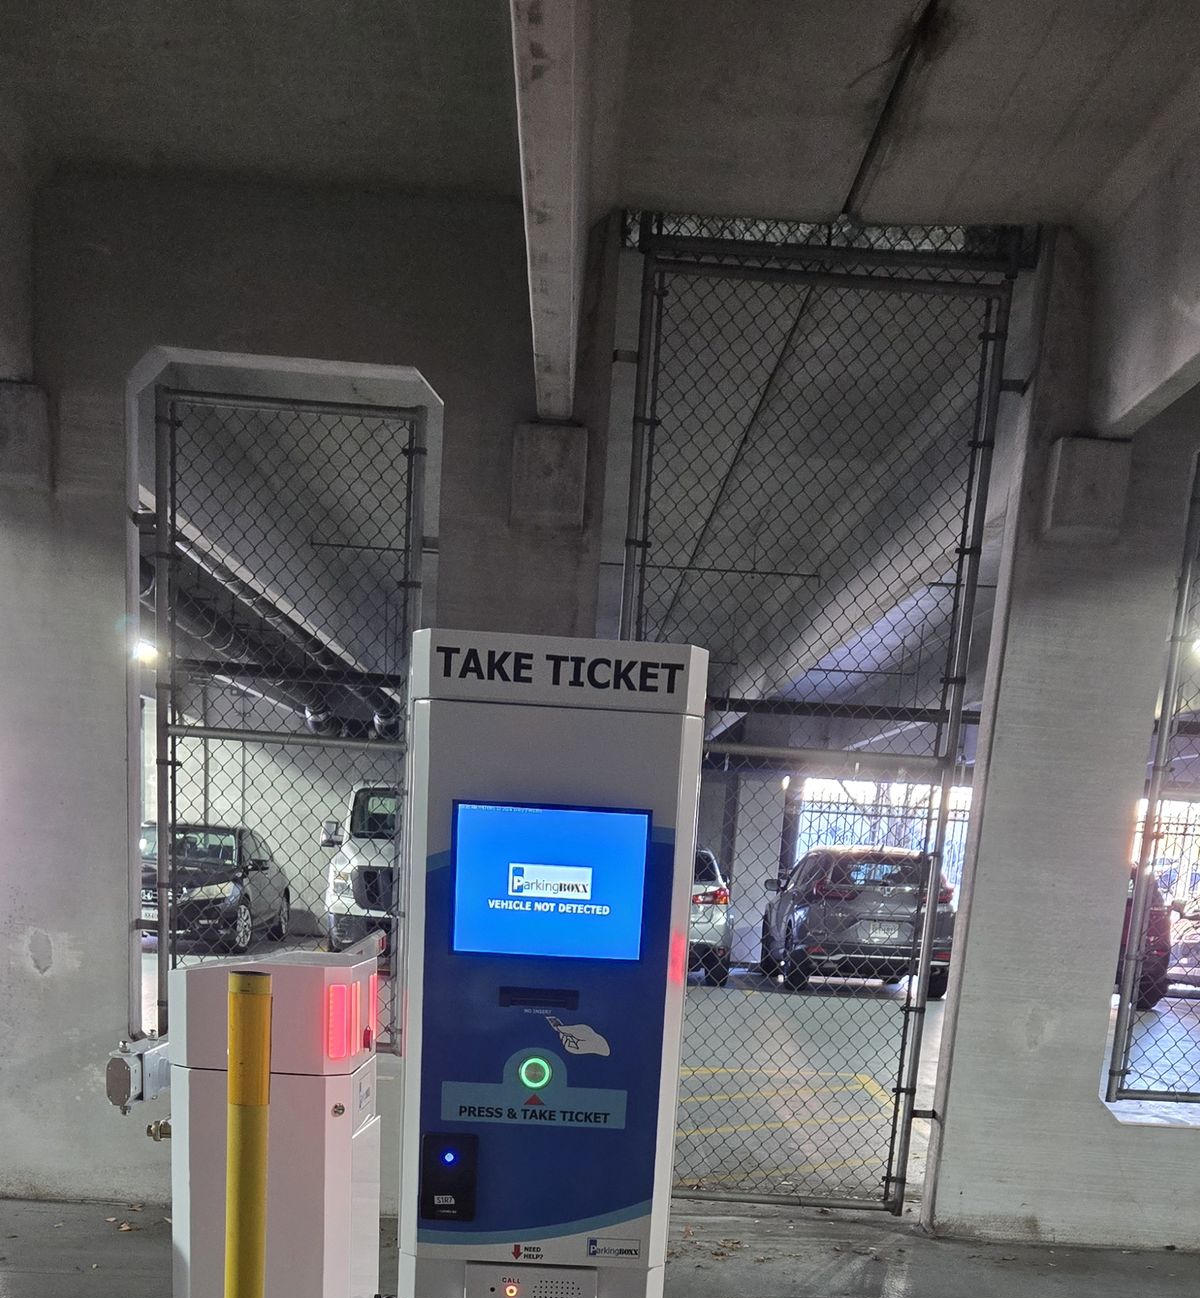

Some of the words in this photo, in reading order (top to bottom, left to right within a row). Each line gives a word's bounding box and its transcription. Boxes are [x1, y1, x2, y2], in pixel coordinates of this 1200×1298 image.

[436, 646, 534, 683] TAKE
[546, 654, 684, 694] TICKET
[512, 875, 589, 894] ParkingBOXX
[488, 899, 532, 911] VEHICLE
[534, 902, 556, 913] NOT
[558, 903, 610, 915] DETECTED
[459, 1105, 503, 1118] PRESS
[507, 1107, 517, 1120] &
[521, 1108, 556, 1121] TAKE
[560, 1110, 610, 1124] TICKET
[590, 1244, 639, 1256] ParkingBOXX
